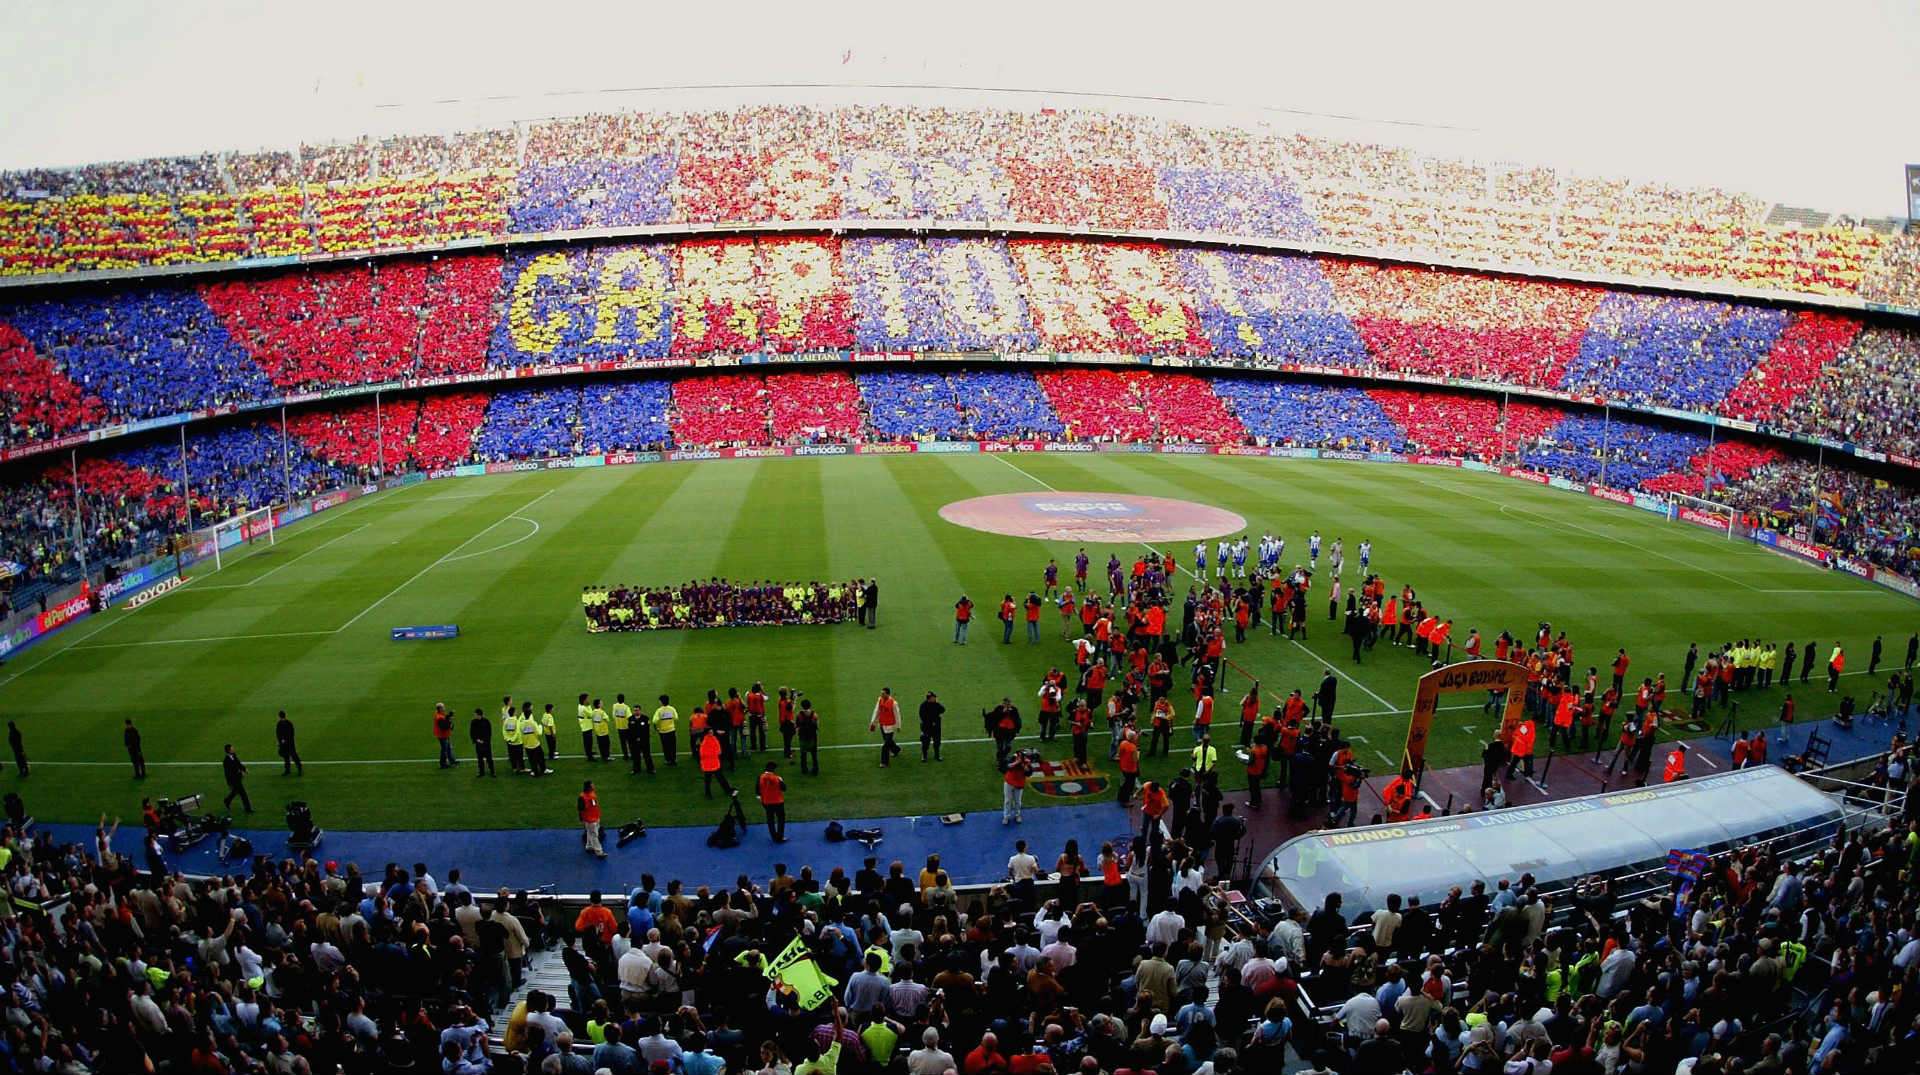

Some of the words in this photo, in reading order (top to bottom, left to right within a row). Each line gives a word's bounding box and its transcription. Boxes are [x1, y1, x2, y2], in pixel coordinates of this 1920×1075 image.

[768, 352, 795, 362] CAIXA
[797, 353, 840, 361] LAIETANA
[422, 376, 450, 387] Caixa
[456, 369, 502, 383] Sabadell
[985, 443, 1035, 452] elPerdico
[128, 576, 182, 608] TOYOTA
[1332, 828, 1406, 846] MUNDO
[1407, 824, 1461, 837] DEPORTIVO
